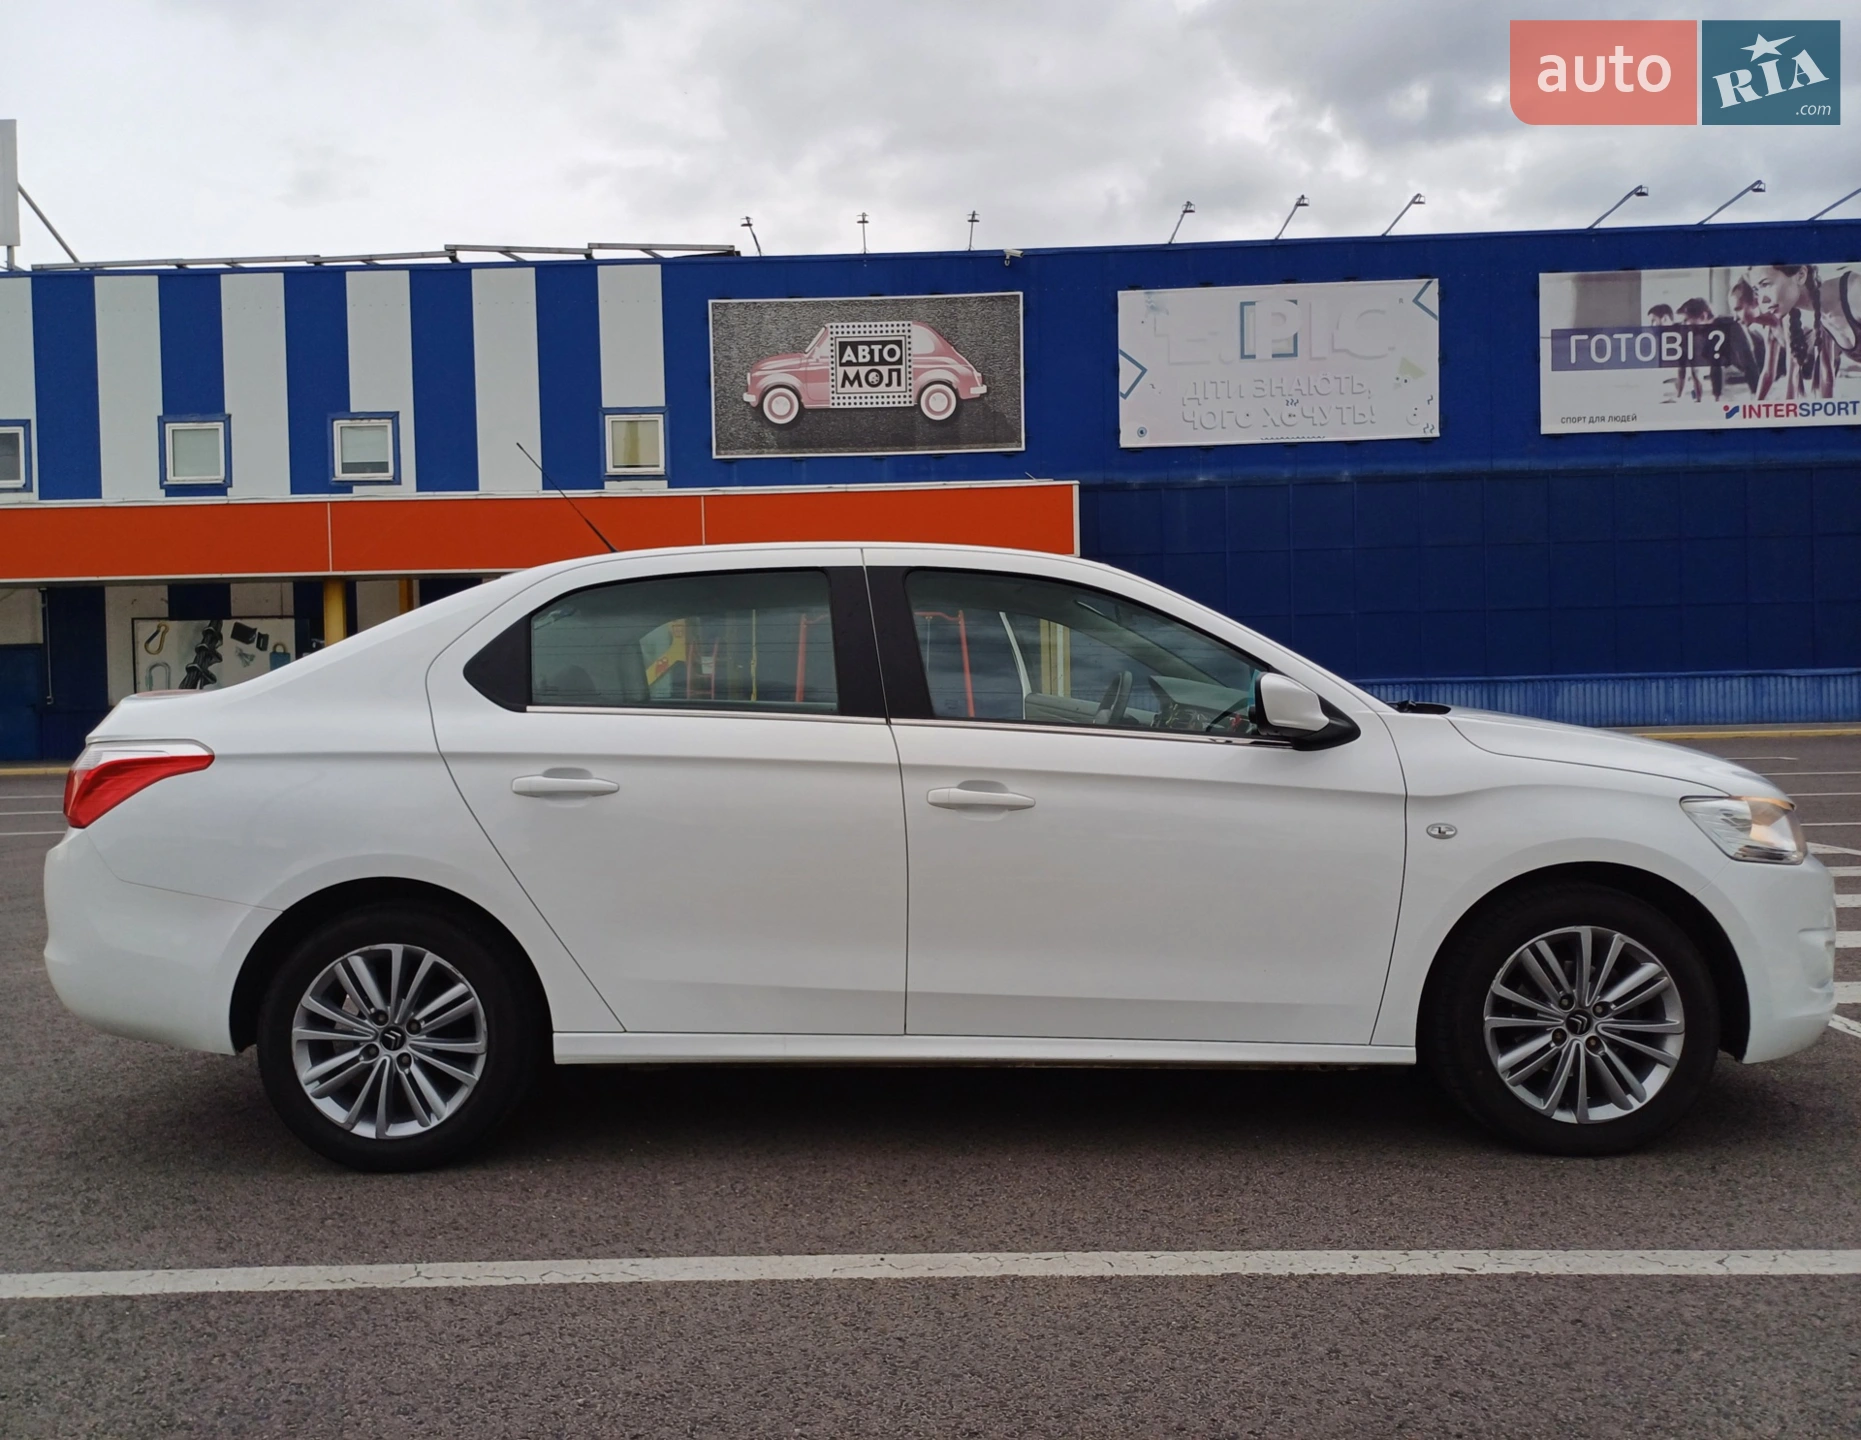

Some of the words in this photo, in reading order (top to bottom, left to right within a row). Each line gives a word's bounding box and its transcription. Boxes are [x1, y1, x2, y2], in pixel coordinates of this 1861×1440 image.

[841, 344, 901, 363] АВТО
[1569, 331, 1694, 365] ГОТОВІ
[1707, 330, 1726, 360] ?
[841, 368, 901, 388] МОЛ
[1560, 416, 1587, 424] СПОРТ
[1588, 416, 1606, 424] ДЛЯ
[1607, 414, 1638, 424] ЛЮДЕЙ
[1742, 400, 1860, 419] INTERSPORT
